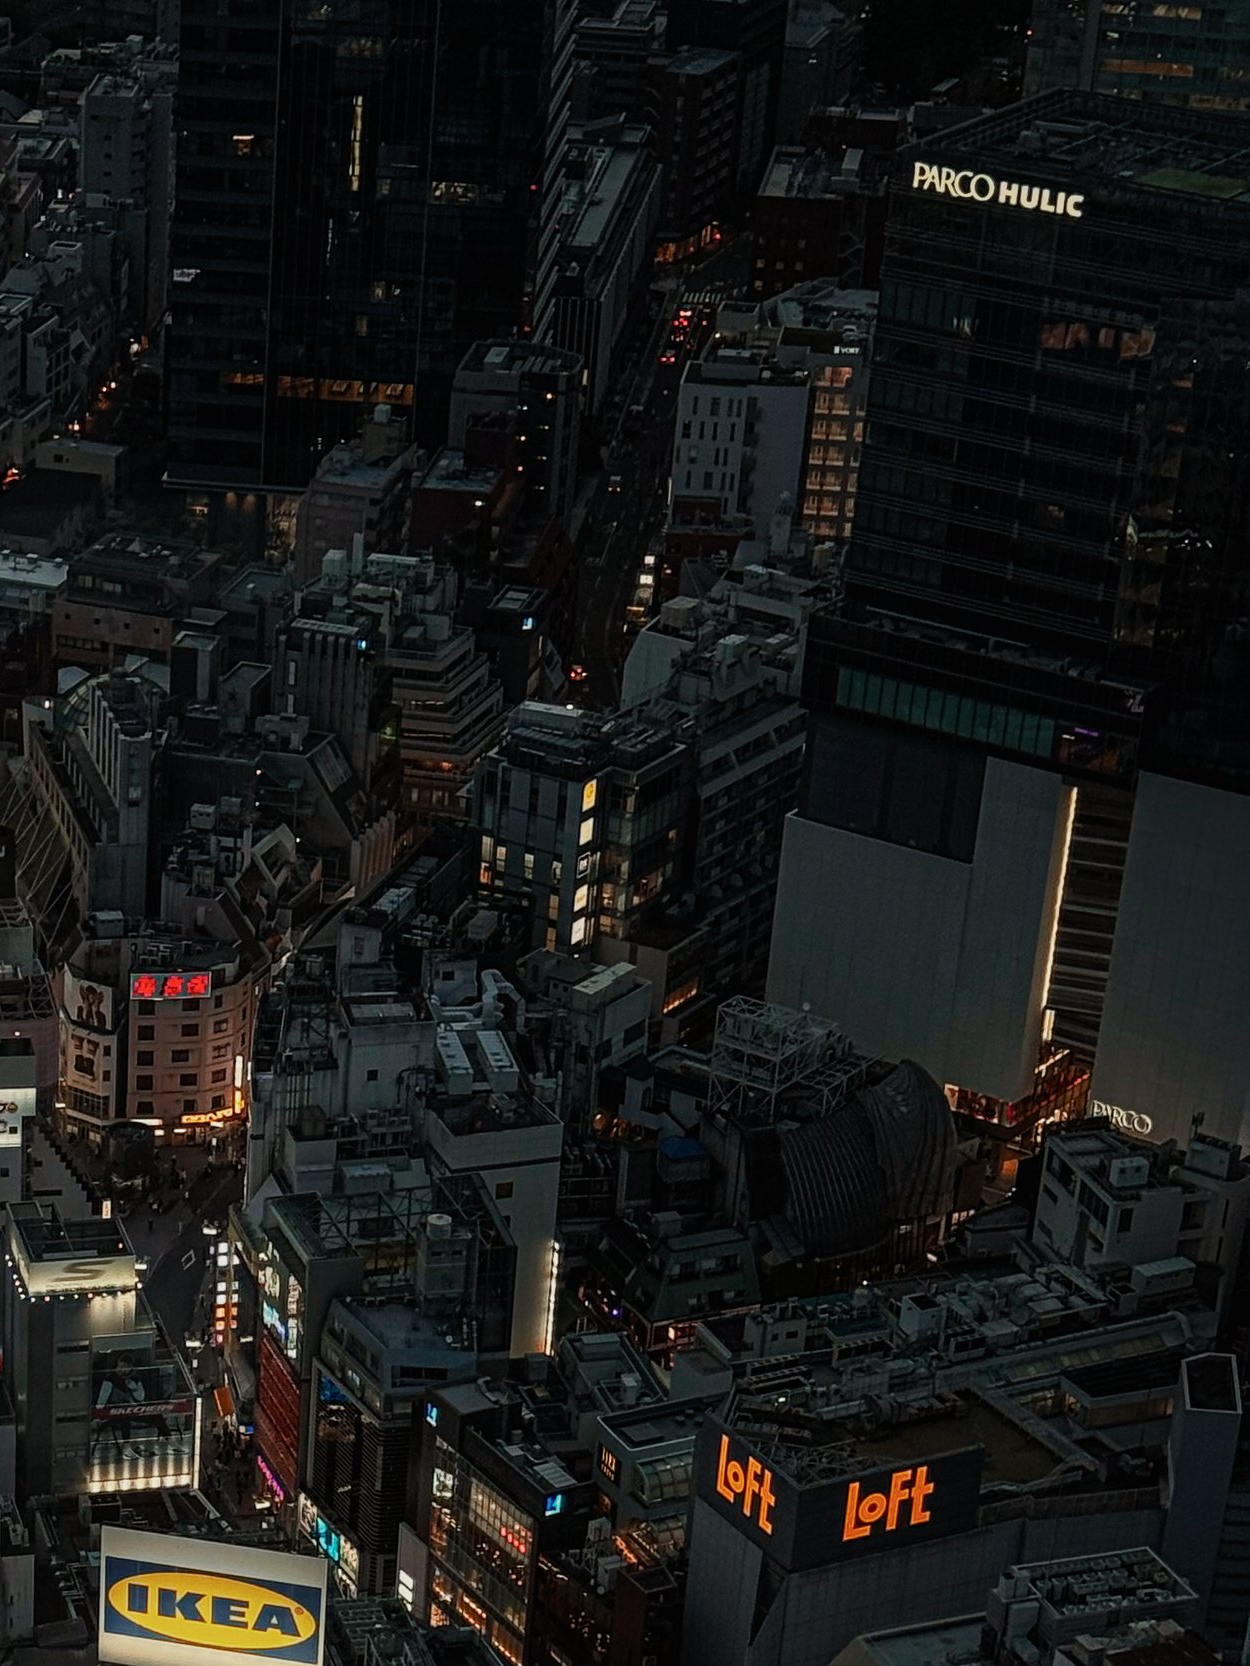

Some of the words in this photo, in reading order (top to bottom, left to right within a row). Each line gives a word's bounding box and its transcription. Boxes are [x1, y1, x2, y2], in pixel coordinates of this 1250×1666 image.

[912, 161, 996, 202] PARCO
[998, 180, 1086, 219] HULIC
[1093, 1100, 1152, 1135] PARCO
[109, 1404, 174, 1416] SKECHERS
[127, 1583, 302, 1638] IKEA
